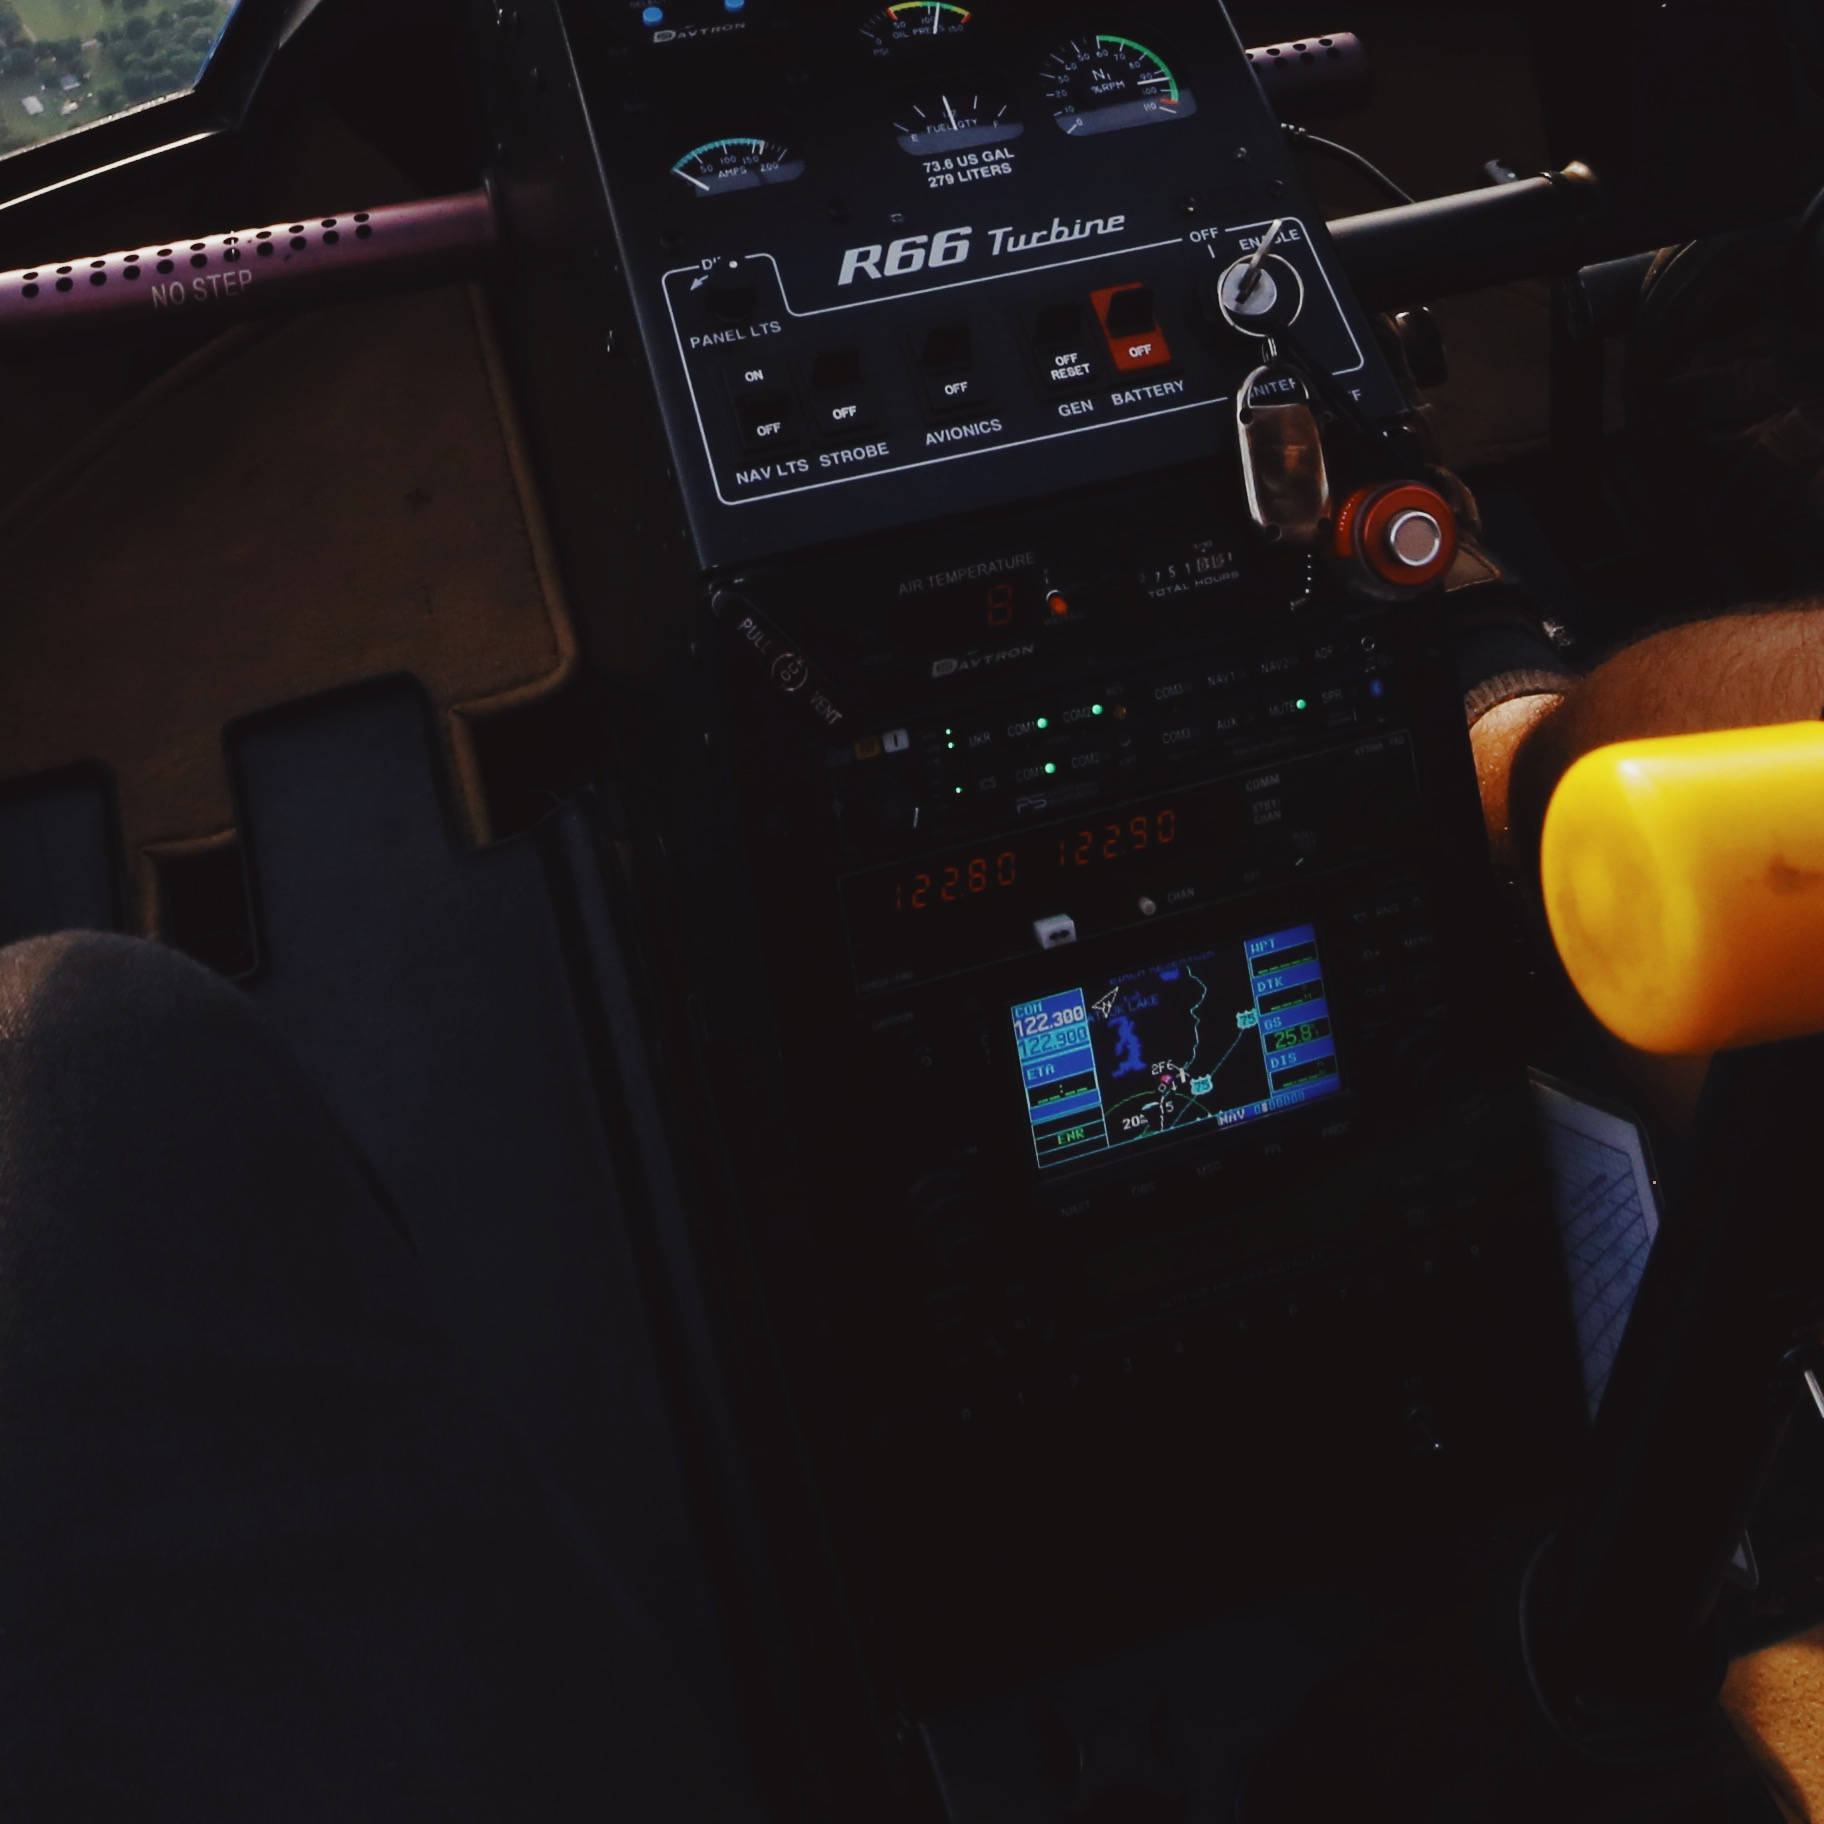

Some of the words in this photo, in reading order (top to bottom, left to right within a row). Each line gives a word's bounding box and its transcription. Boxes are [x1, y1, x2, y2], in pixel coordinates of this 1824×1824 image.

[653, 22, 746, 44] DAVTRON
[926, 121, 953, 134] FUEL
[922, 159, 954, 174] 73.6
[956, 152, 979, 167] US
[981, 146, 1015, 163] GAL
[718, 165, 748, 179] AMPS
[927, 174, 955, 189] 279
[958, 161, 1013, 184] LITERS
[1189, 227, 1219, 244] OFF
[837, 225, 974, 286] R66
[987, 214, 1127, 257] Turbine
[151, 280, 186, 309] NO
[191, 269, 253, 302] STEP
[690, 329, 746, 349] PANEL
[750, 320, 783, 337] LTS
[1054, 352, 1079, 367] OFF
[1129, 344, 1153, 358] OFF
[744, 369, 764, 383] ON
[1050, 362, 1092, 382] RESET
[944, 381, 969, 396] OFF
[1110, 379, 1185, 407] BATTERY
[832, 405, 857, 420] OFF
[1057, 398, 1095, 418] GEN
[756, 421, 781, 437] OFF
[925, 417, 1004, 446] AVIONICS
[818, 441, 891, 468] STROBE
[735, 465, 772, 486] NAV
[775, 458, 810, 477] LTS
[898, 578, 924, 596] AIR
[928, 551, 1035, 589] TEMPERATURE
[1146, 583, 1190, 598] TOTAL
[1194, 569, 1241, 587] HOURS
[932, 642, 1037, 678] DAVTRON
[809, 690, 844, 726] VENT
[1257, 977, 1285, 993] DTK
[1014, 1002, 1044, 1020] COM
[1127, 993, 1161, 1014] LAKE
[1270, 1052, 1298, 1069] DIS
[1026, 1062, 1056, 1082] ETA
[1217, 1108, 1246, 1127] NAV
[1057, 1127, 1087, 1145] ENR
